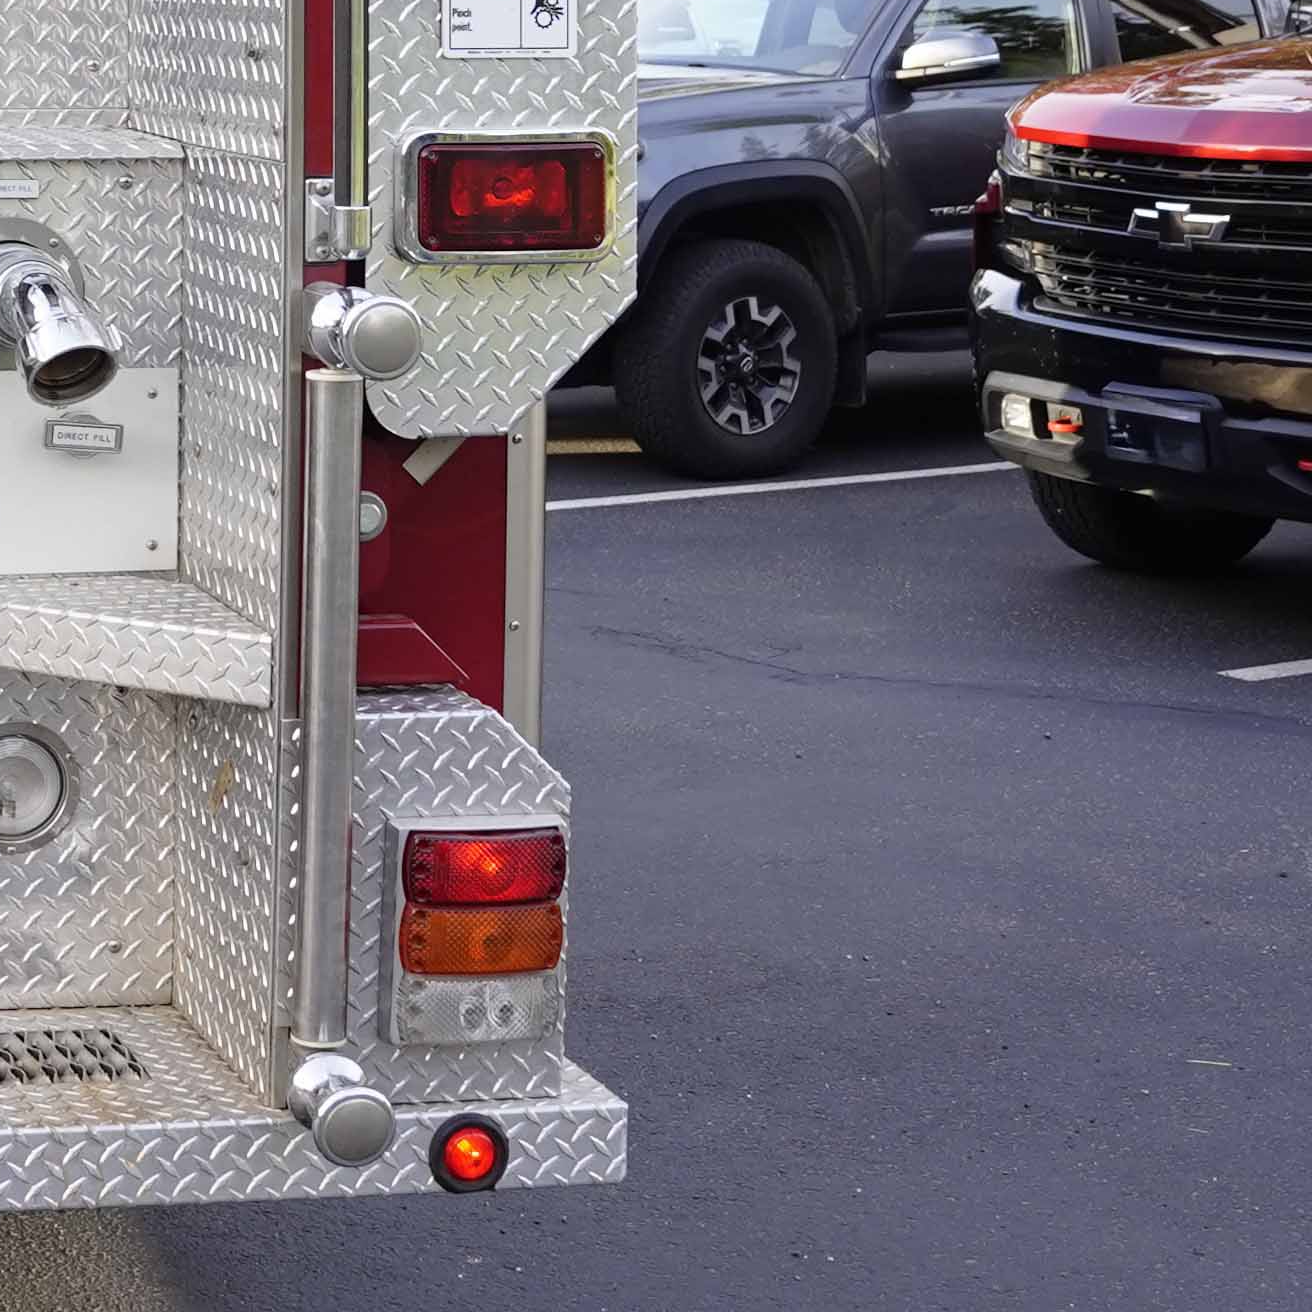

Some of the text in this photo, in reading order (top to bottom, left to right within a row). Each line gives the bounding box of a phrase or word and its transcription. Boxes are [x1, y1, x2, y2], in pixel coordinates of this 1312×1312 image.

[452, 7, 472, 17] Pinch
[57, 431, 112, 443] DIRECT FILL
